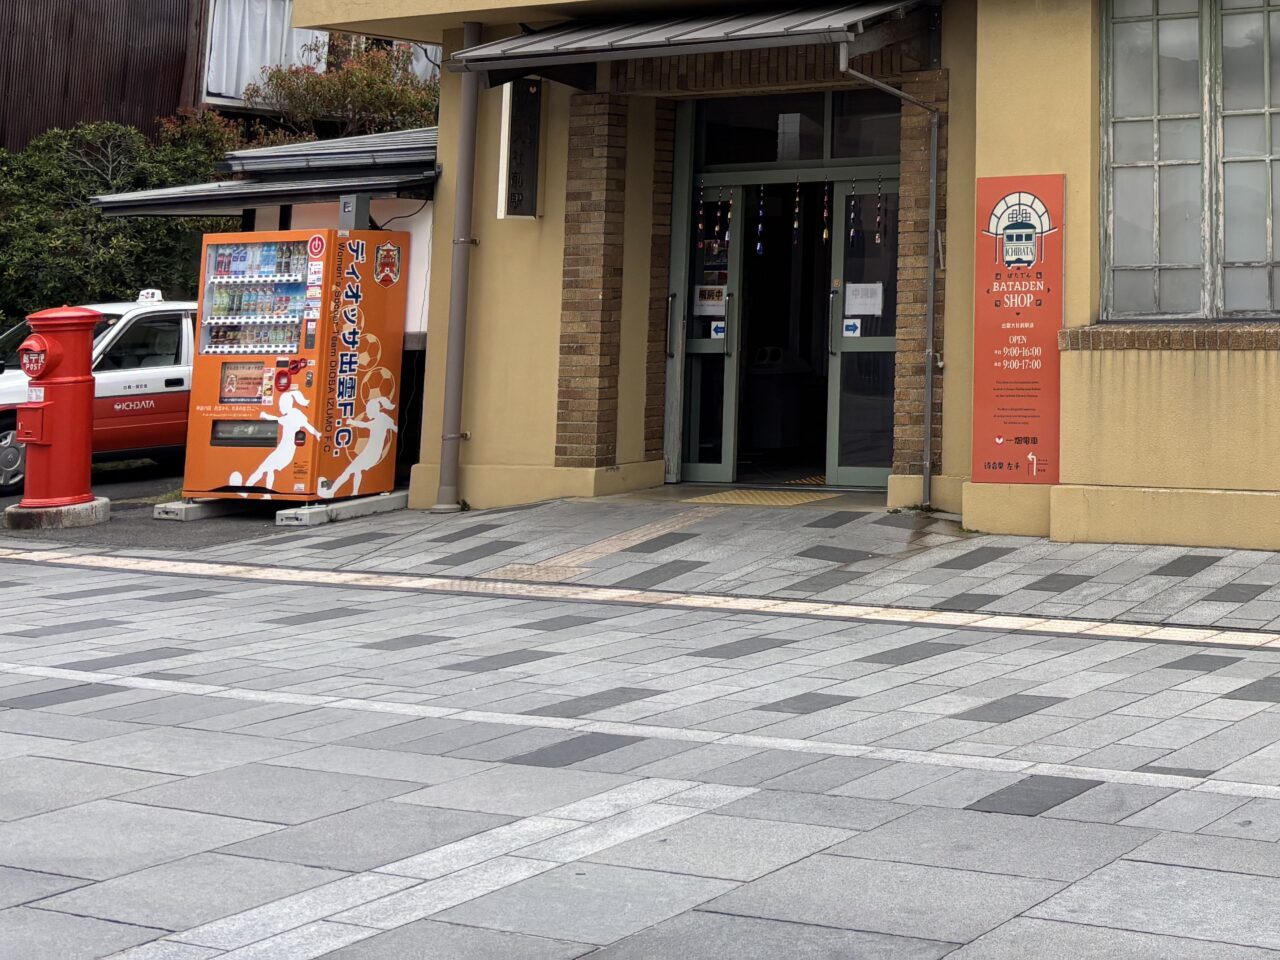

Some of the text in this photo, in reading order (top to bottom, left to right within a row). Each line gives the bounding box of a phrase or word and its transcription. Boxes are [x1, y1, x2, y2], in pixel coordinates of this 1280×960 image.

[1005, 246, 1034, 257] ICHIBATA
[992, 281, 1044, 292] BATADEN
[1003, 293, 1034, 308] SHOP
[329, 331, 340, 357] Team
[1009, 335, 1027, 344] OPEN
[332, 240, 366, 457] ディオッサ出雲F.C.
[1003, 346, 1042, 357] 9:00-16:00
[25, 363, 42, 371] POST
[1003, 359, 1042, 370] 9:00-17:00
[324, 398, 335, 433] IZUMO
